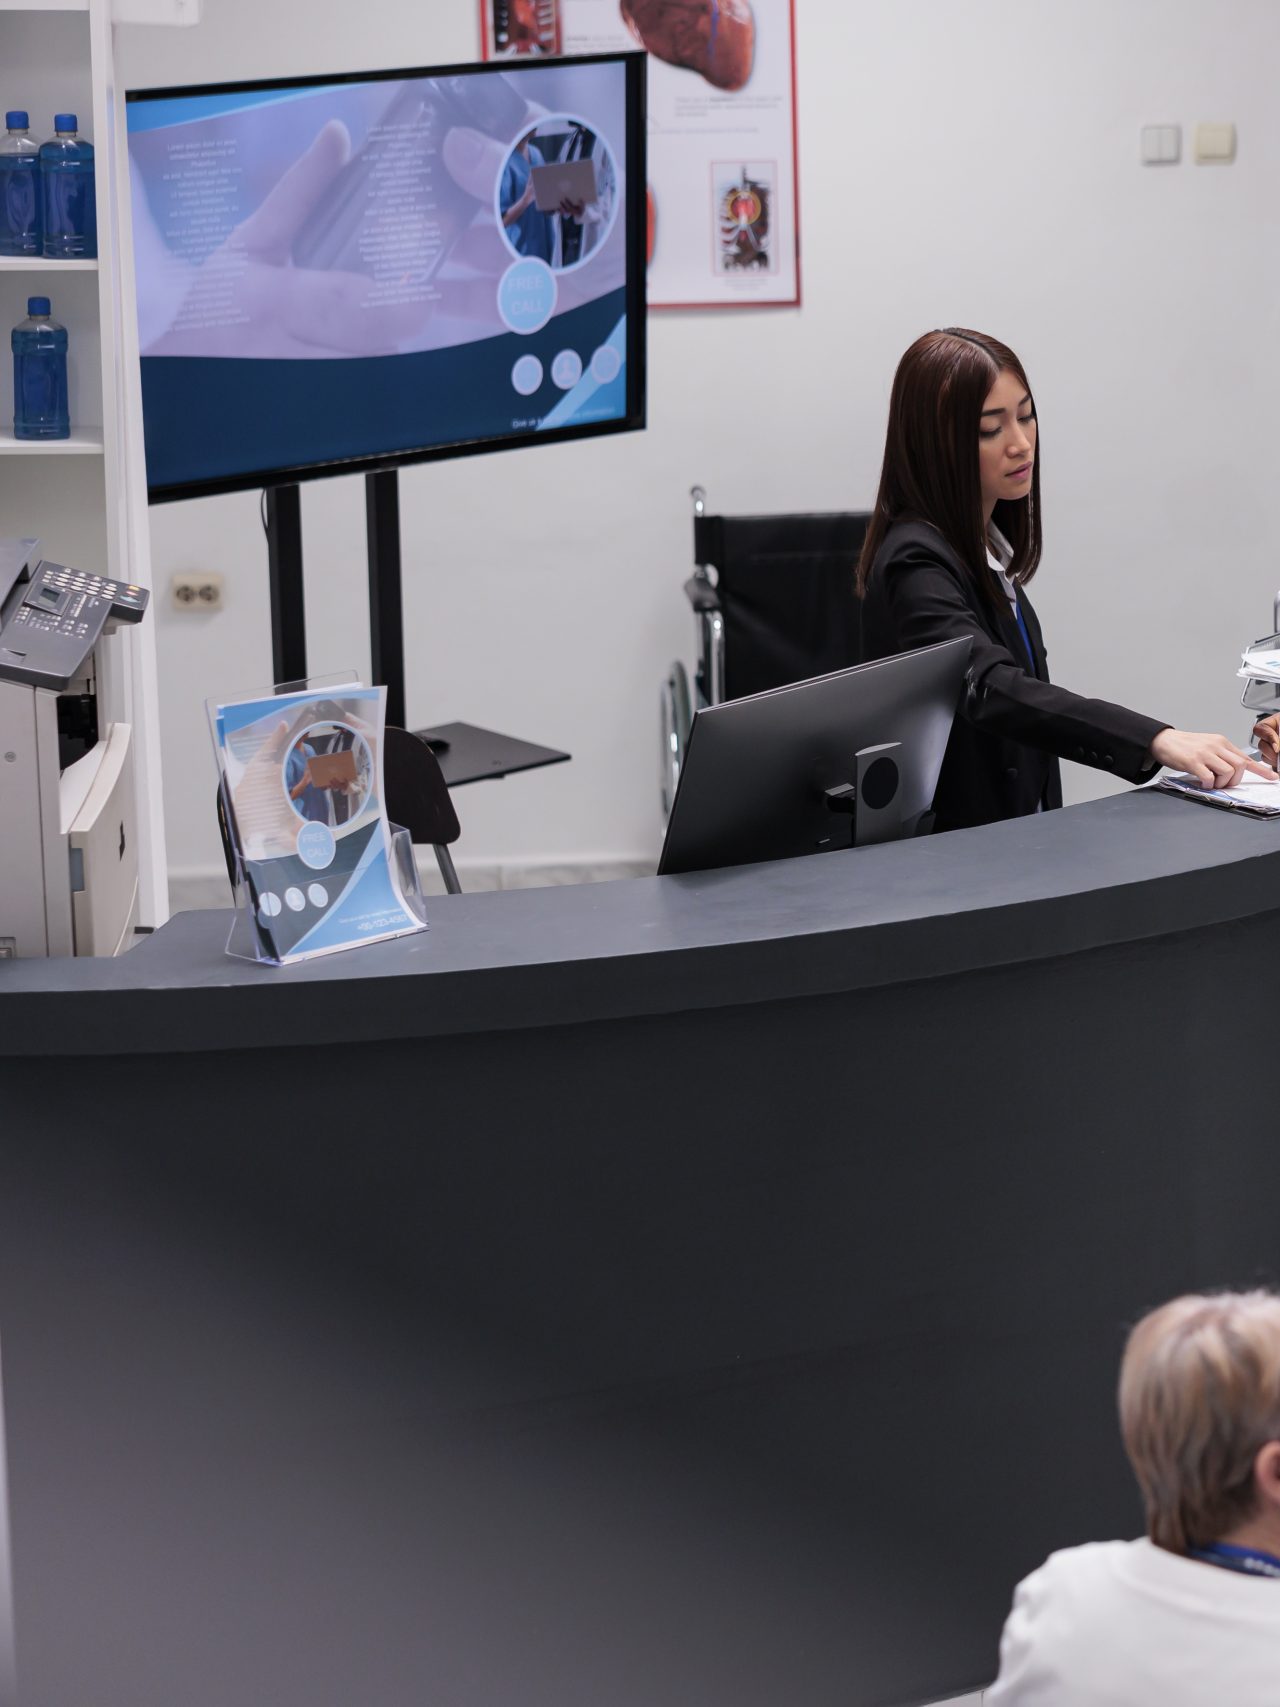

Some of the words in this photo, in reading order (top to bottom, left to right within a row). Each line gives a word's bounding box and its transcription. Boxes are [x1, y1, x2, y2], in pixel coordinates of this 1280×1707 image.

[508, 275, 545, 293] FREE
[512, 299, 545, 316] CALL
[303, 832, 327, 844] FREE
[308, 847, 329, 858] CALL
